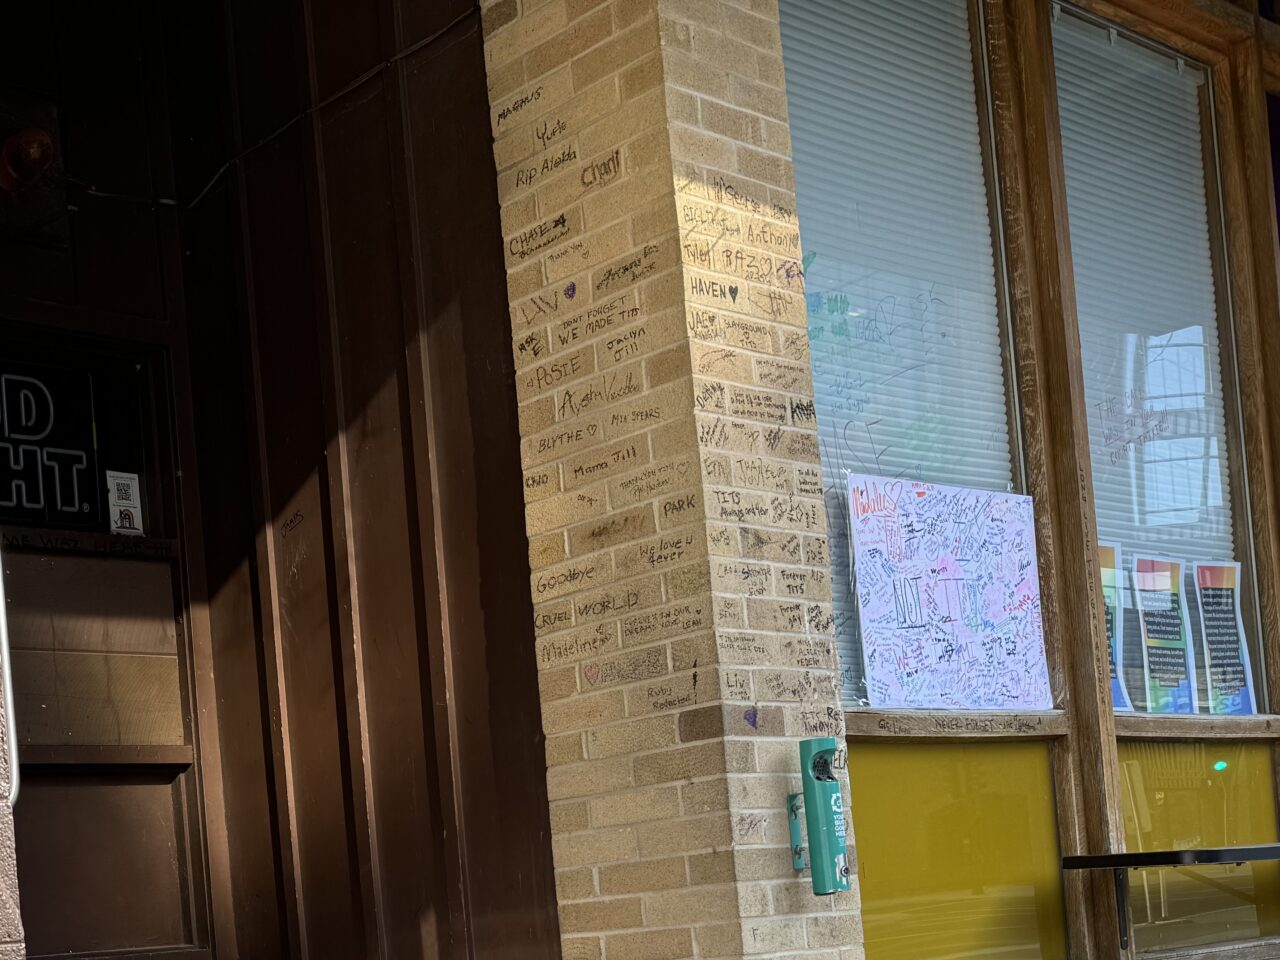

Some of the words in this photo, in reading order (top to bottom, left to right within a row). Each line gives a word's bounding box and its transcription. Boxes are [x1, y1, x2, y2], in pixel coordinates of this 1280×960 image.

[509, 222, 551, 256] CHASE
[689, 275, 727, 301] HAVEN
[585, 315, 616, 335] MADE
[619, 307, 640, 322] TITS
[538, 429, 584, 455] BLYTHE
[662, 494, 696, 518] PARK
[712, 490, 741, 505] TITS
[660, 539, 683, 553] love
[534, 611, 572, 631] CRUEL
[577, 589, 640, 617] WORLD
